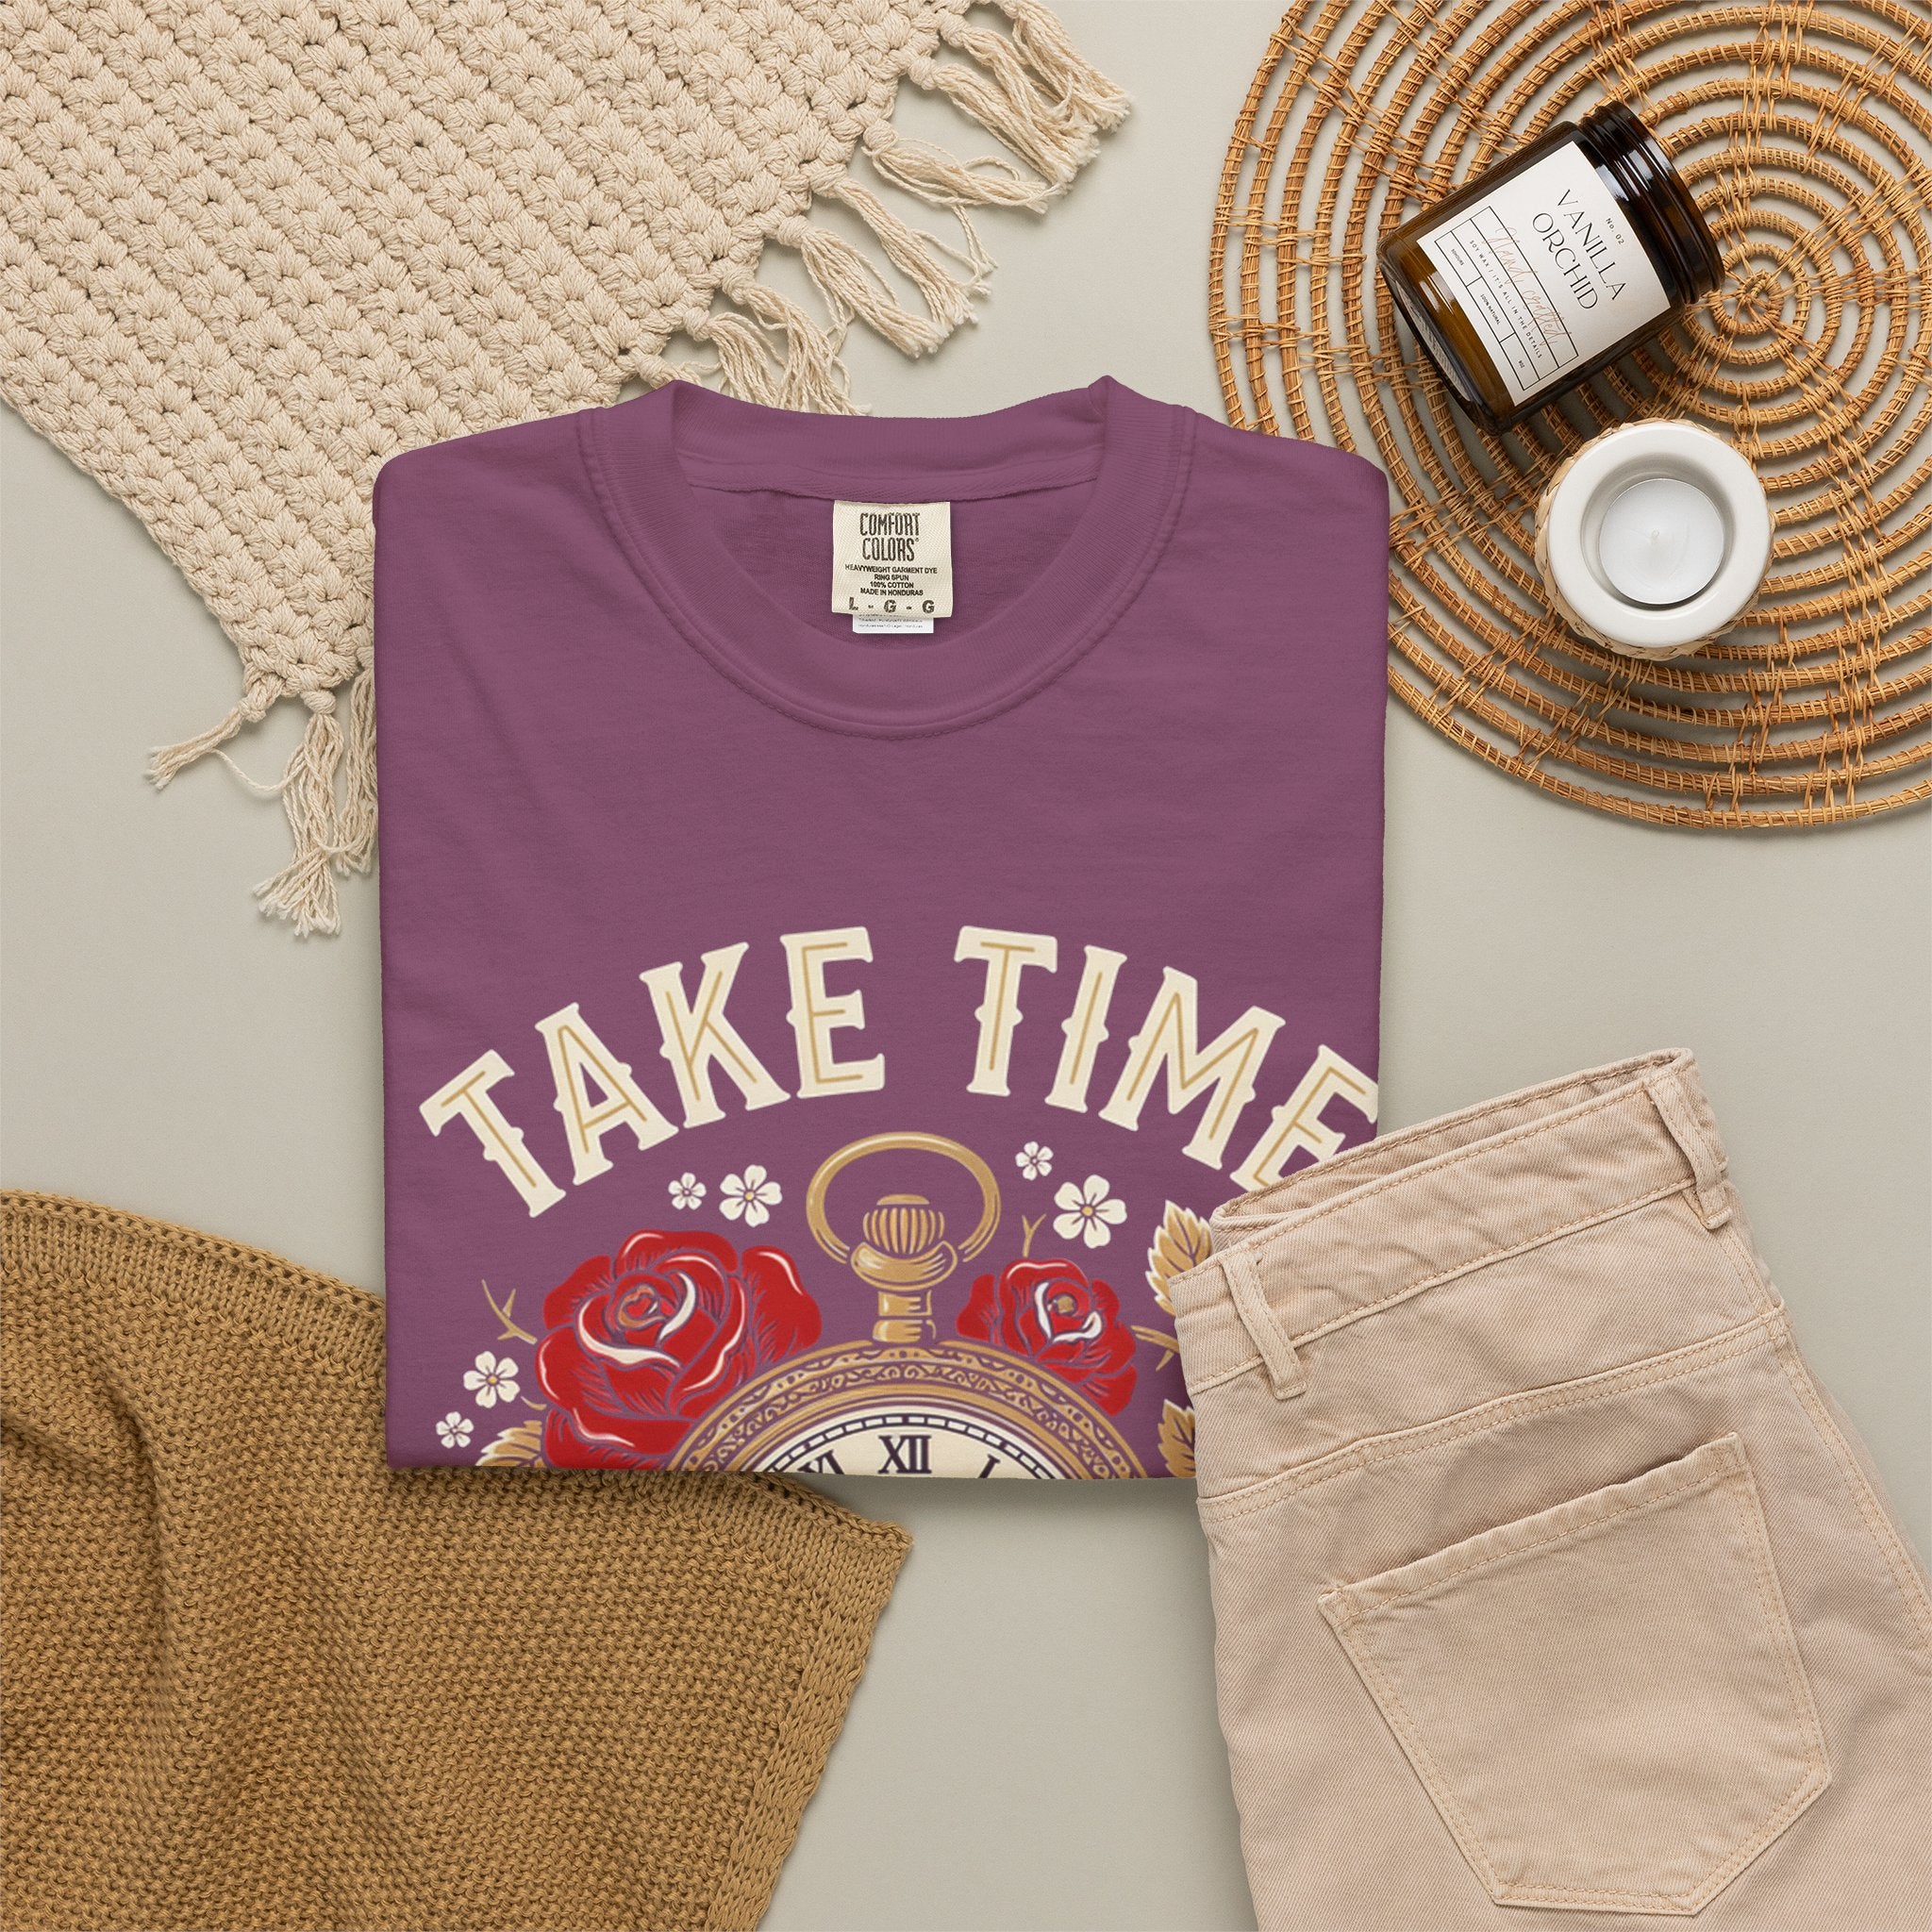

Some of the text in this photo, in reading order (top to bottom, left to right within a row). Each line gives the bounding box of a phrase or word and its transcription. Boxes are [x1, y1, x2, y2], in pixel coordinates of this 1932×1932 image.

[1557, 189, 1626, 301] VANILLA
[1615, 233, 1624, 245] 02
[1532, 212, 1598, 309] ORCHID
[1470, 240, 1479, 252] SOY
[1479, 254, 1490, 267] WAX
[1492, 275, 1504, 289] IT'S
[1503, 291, 1511, 304] ALL
[1511, 307, 1519, 315] IN
[1518, 317, 1527, 329] THE
[1526, 332, 1542, 358] DETAILS
[1489, 306, 1501, 325] NATURAL
[859, 512, 920, 536] COMFORT
[845, 564, 891, 574] HEAVYWEIGHT
[849, 597, 858, 610] L
[884, 599, 896, 613] G
[923, 600, 935, 613] G
[419, 925, 1379, 1218] TAKE TIME
[877, 1435, 932, 1474] XII
